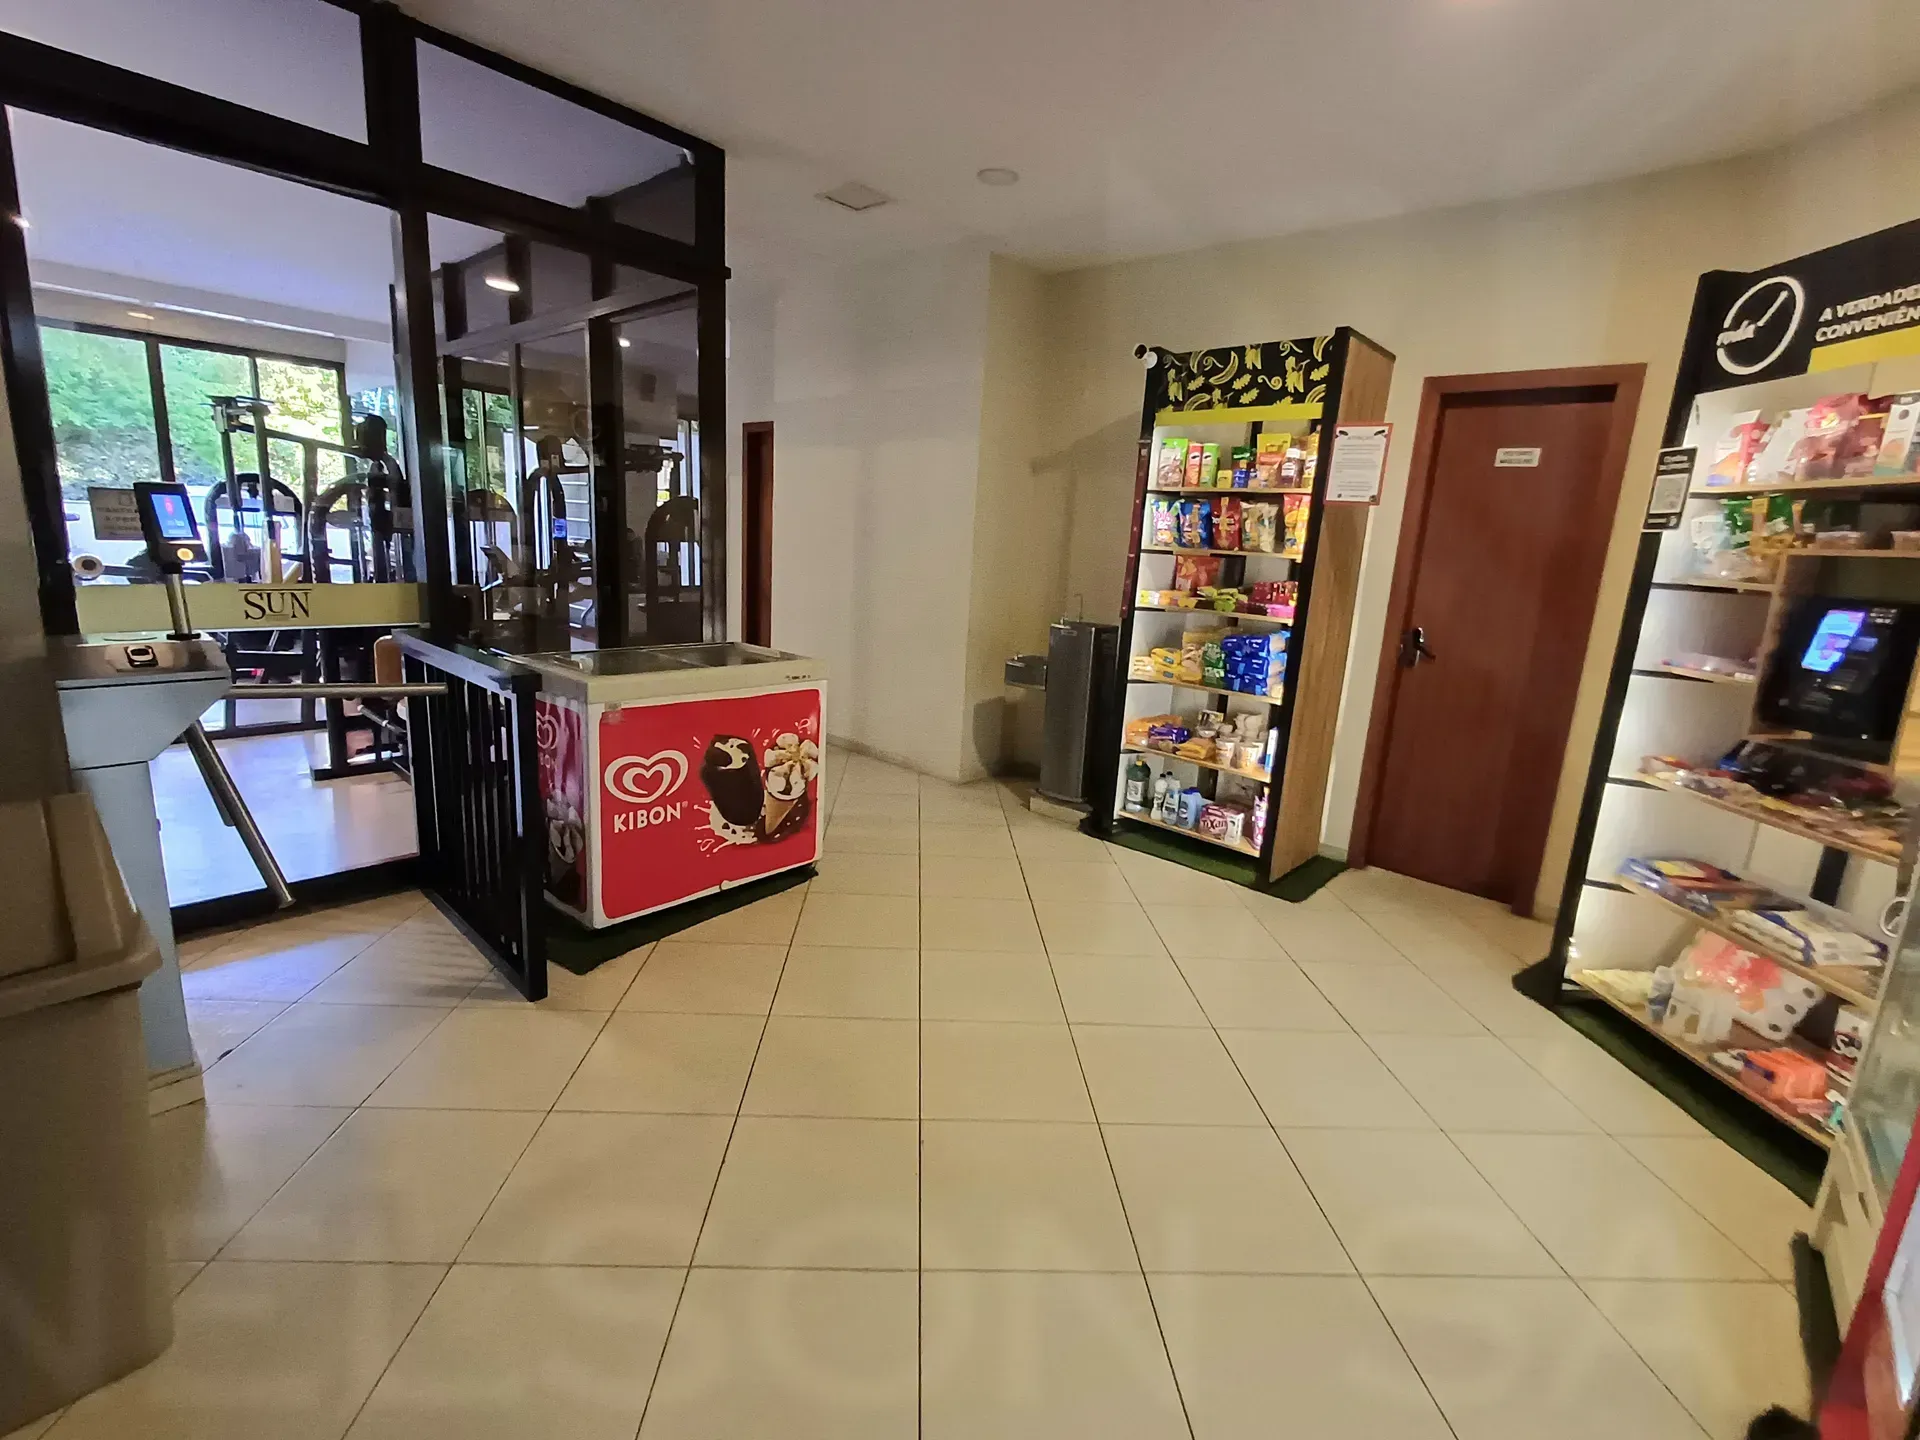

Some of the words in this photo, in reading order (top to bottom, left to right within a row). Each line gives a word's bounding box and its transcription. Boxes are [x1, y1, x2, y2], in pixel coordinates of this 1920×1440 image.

[1818, 307, 1833, 322] A
[243, 591, 312, 620] SUN
[613, 801, 682, 834] KIBON
